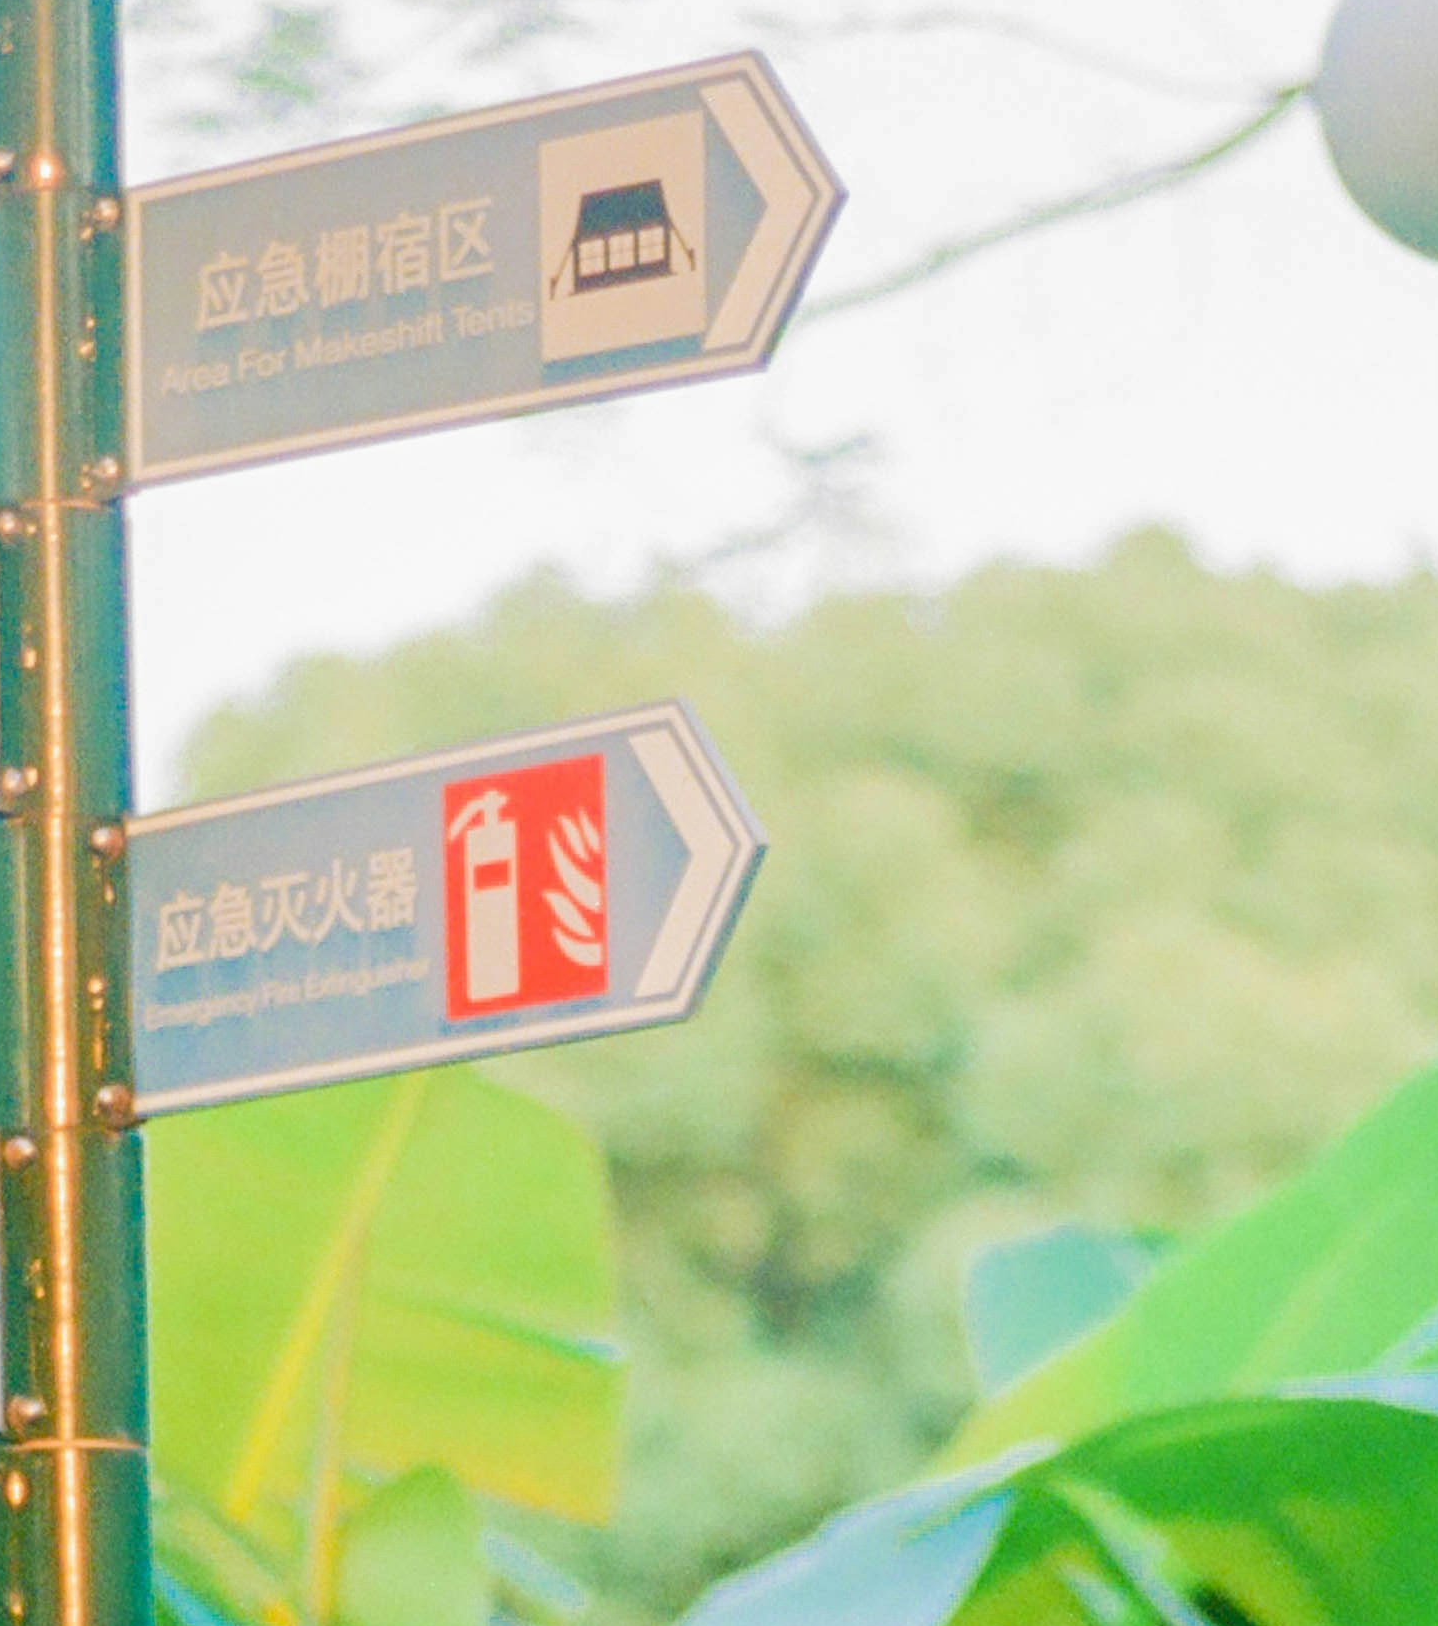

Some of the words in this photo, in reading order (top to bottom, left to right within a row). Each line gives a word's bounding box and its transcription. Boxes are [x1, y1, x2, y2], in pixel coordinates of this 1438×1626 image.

[194, 195, 495, 333] 应急棚宿区
[161, 362, 231, 395] Area
[238, 348, 286, 380] For
[295, 312, 443, 369] Makeshift
[453, 300, 536, 338] Tents
[157, 846, 417, 971] 应急灭火器
